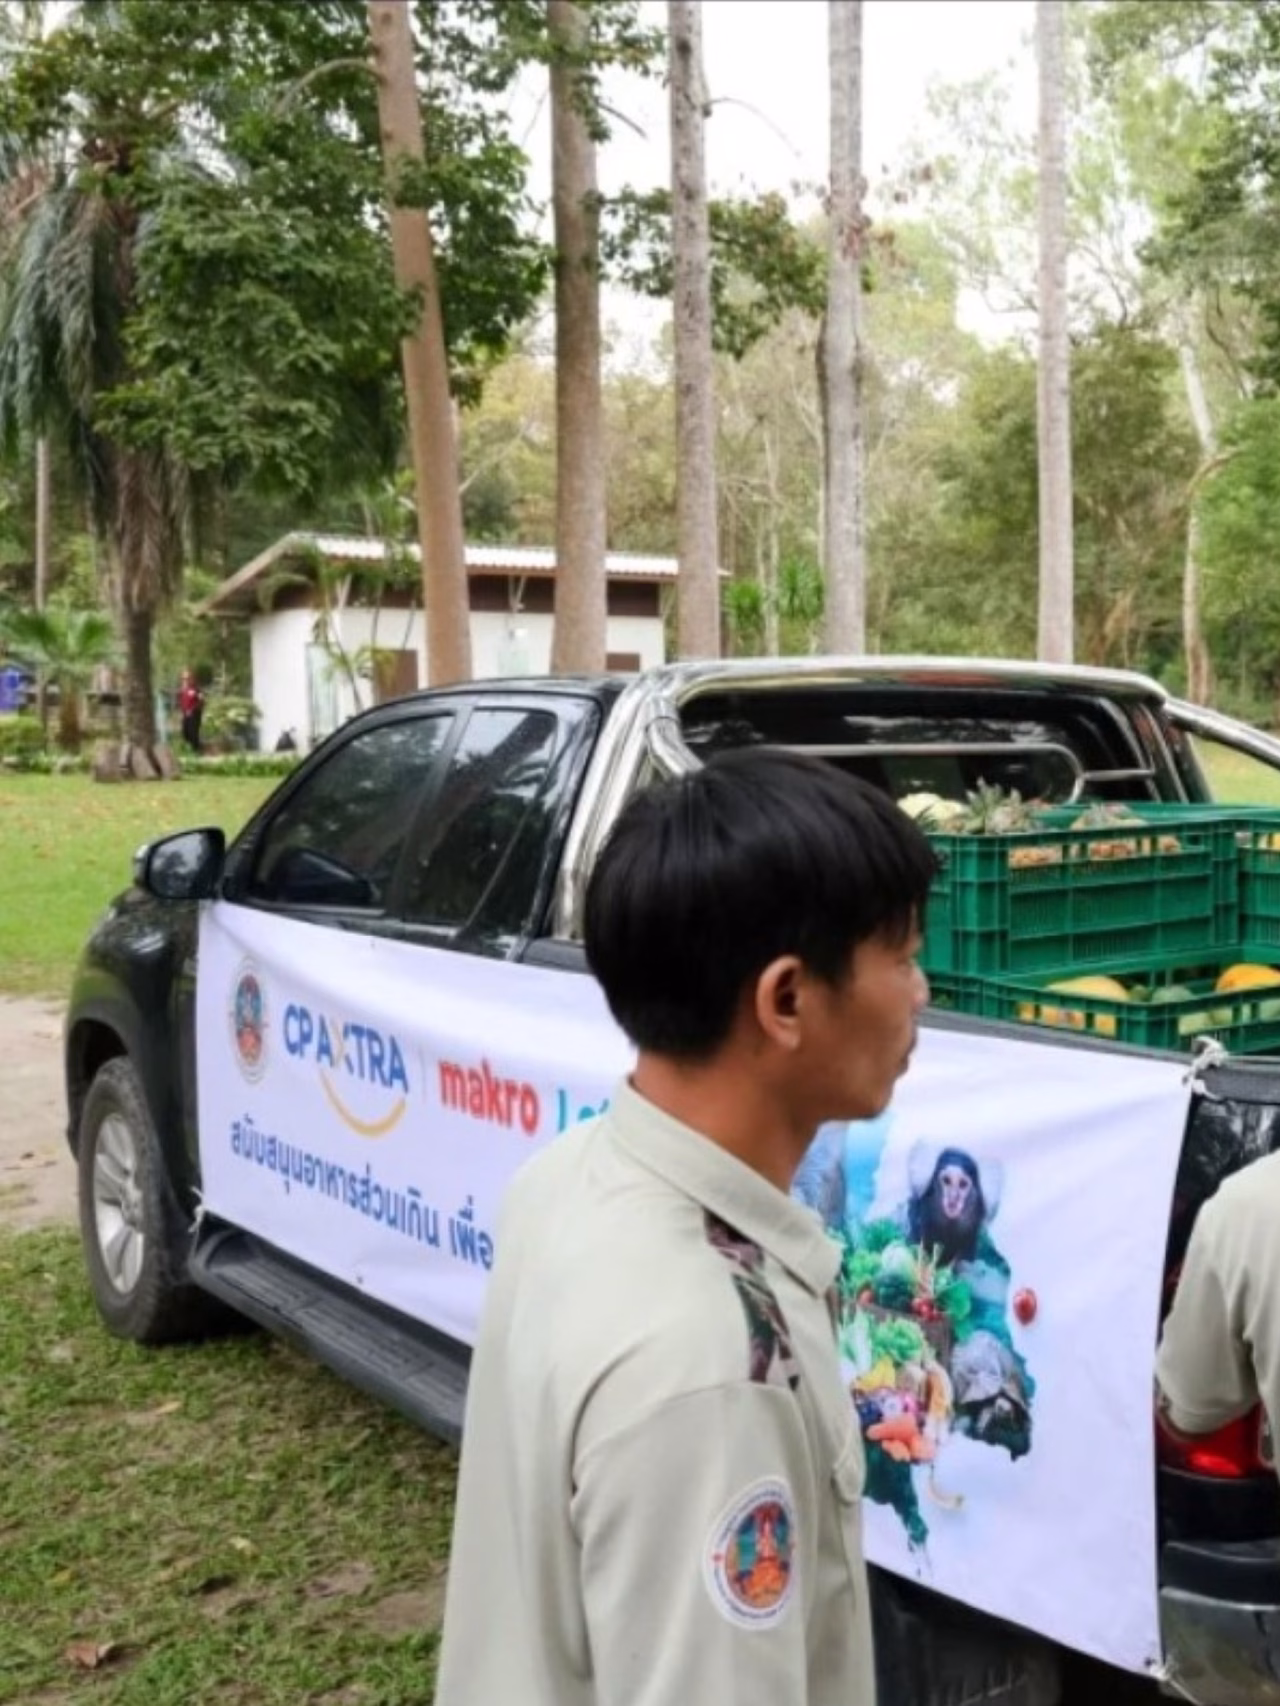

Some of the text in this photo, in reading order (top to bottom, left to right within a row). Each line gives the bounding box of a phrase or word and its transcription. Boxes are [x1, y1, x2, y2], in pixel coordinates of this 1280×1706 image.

[438, 1056, 540, 1137] makro
[230, 1112, 494, 1271] สนับสนุนอาหารส่วนเกิน เพื่อ
